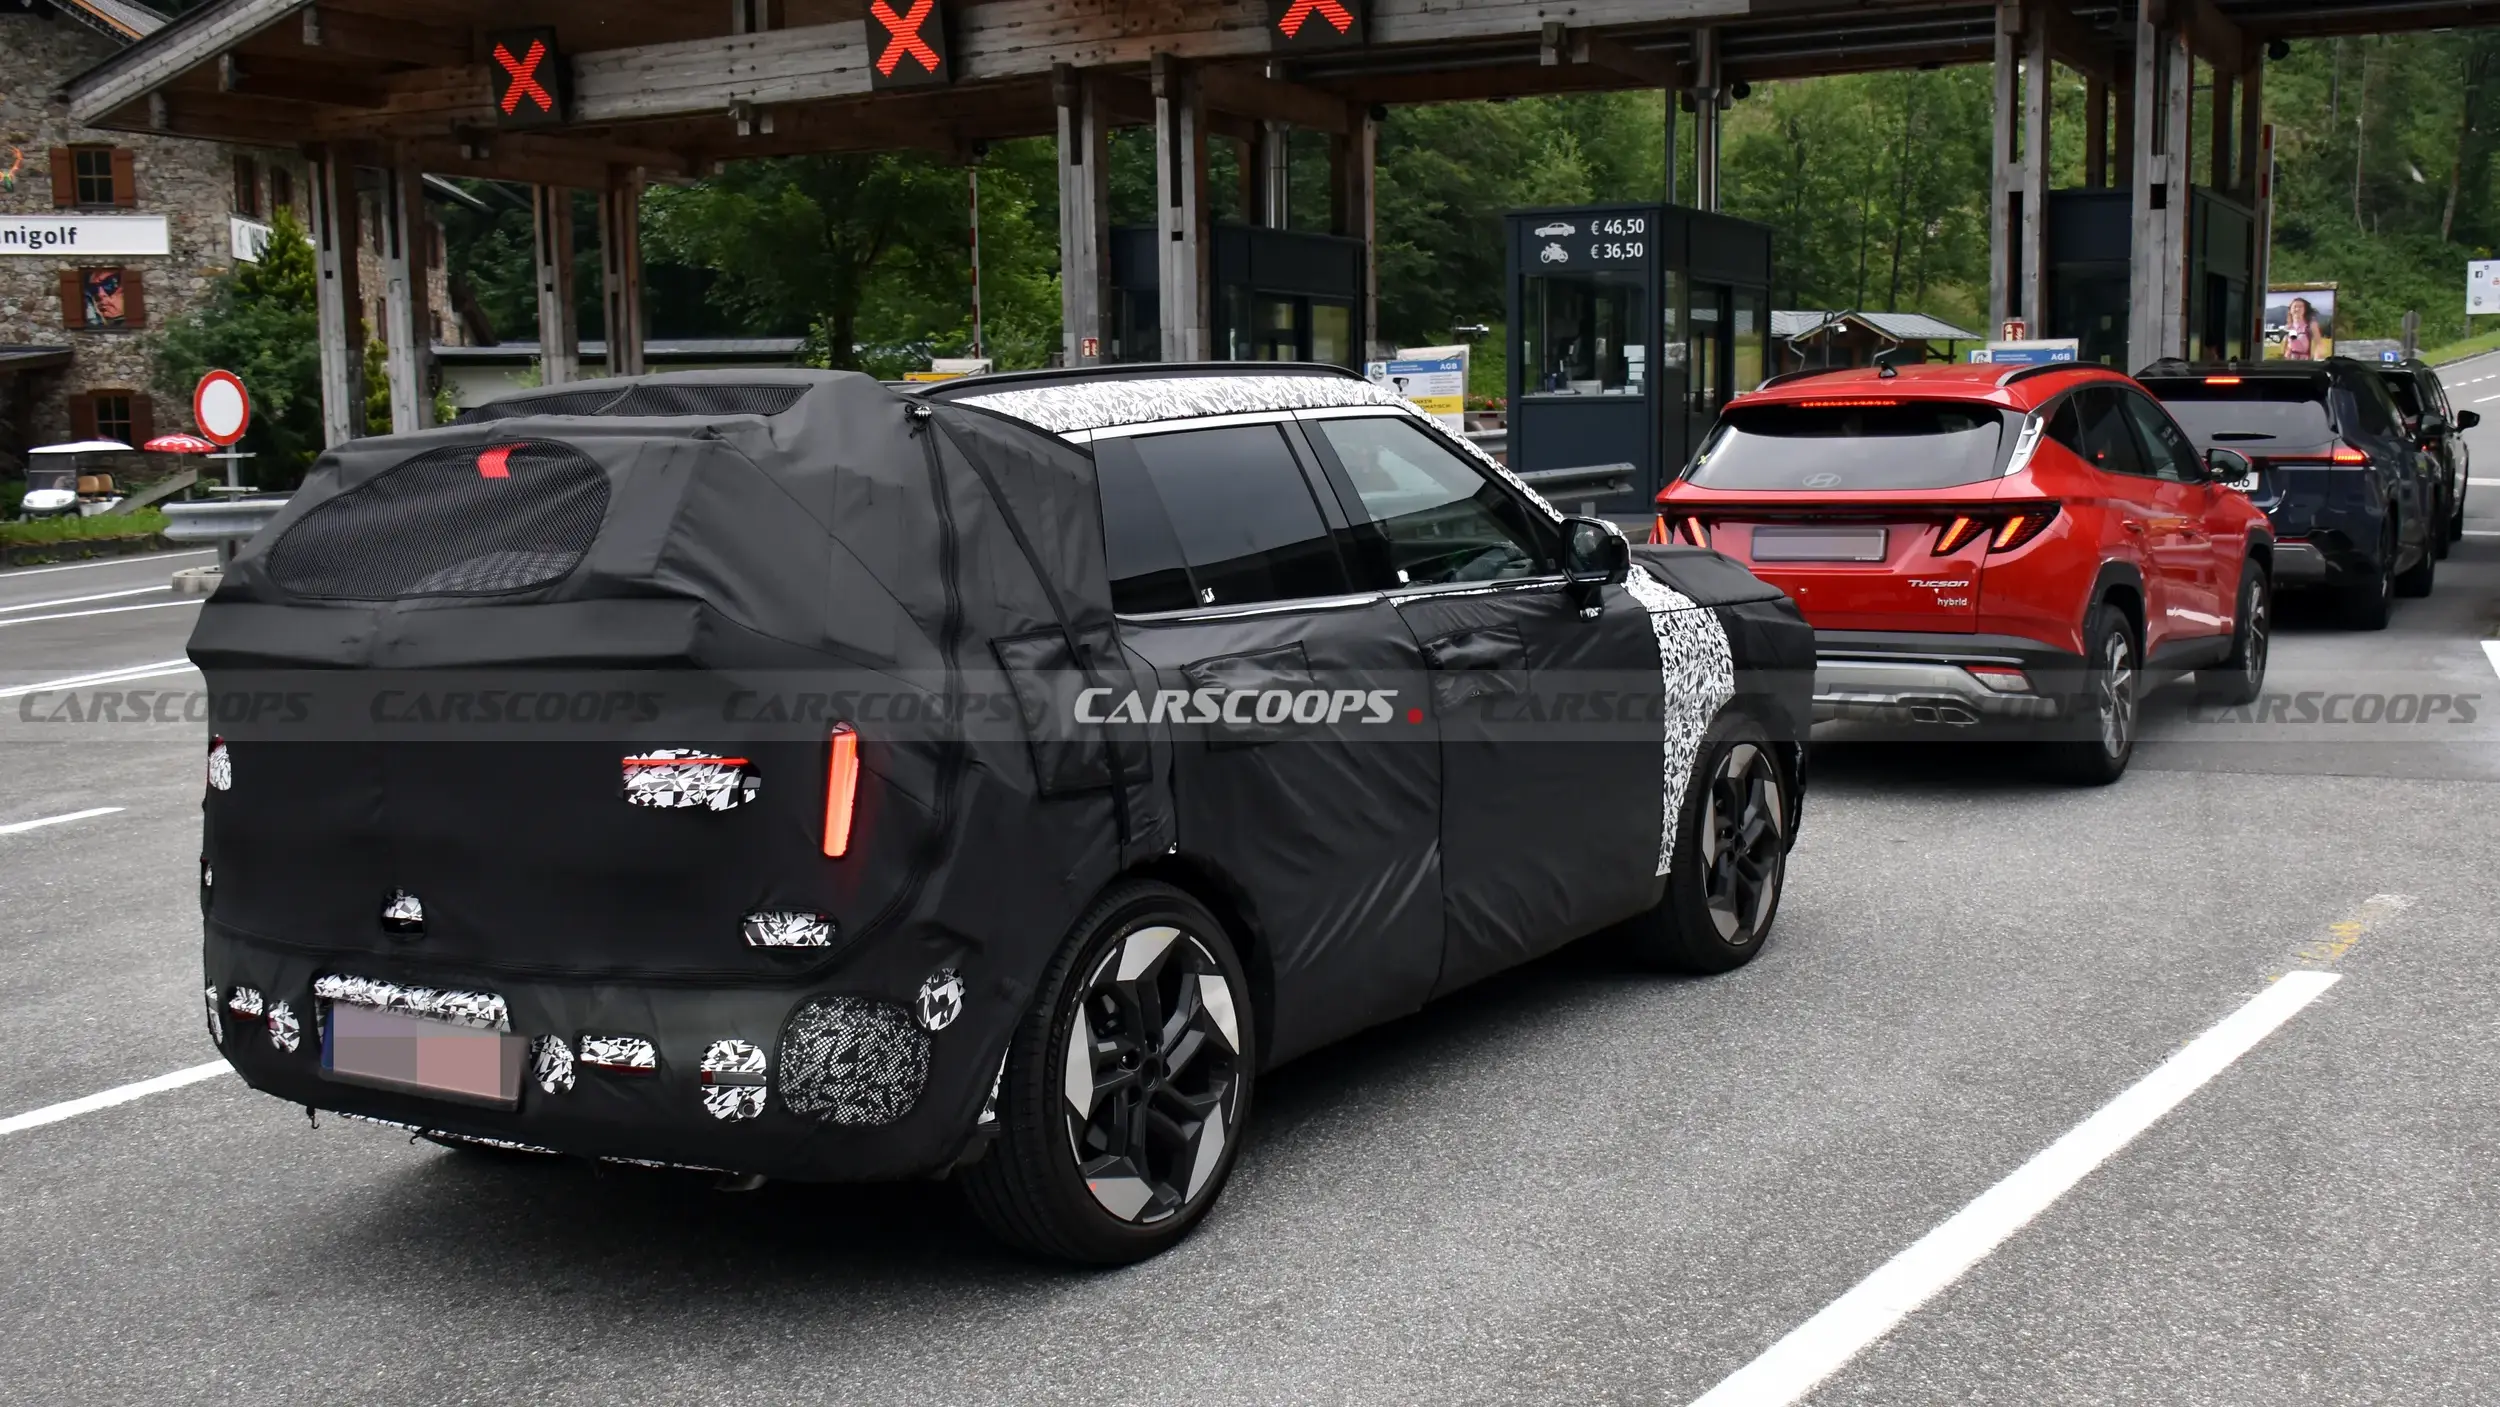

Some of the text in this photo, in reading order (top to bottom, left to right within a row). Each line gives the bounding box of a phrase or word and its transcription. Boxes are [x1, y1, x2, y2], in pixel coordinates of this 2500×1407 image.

[1591, 218, 1645, 236] € 46,50
[0, 225, 78, 250] nigolf
[1590, 242, 1644, 260] € 36,50
[2050, 353, 2071, 361] AGB
[1439, 362, 1458, 371] AGB
[1936, 597, 1968, 608] hybrid
